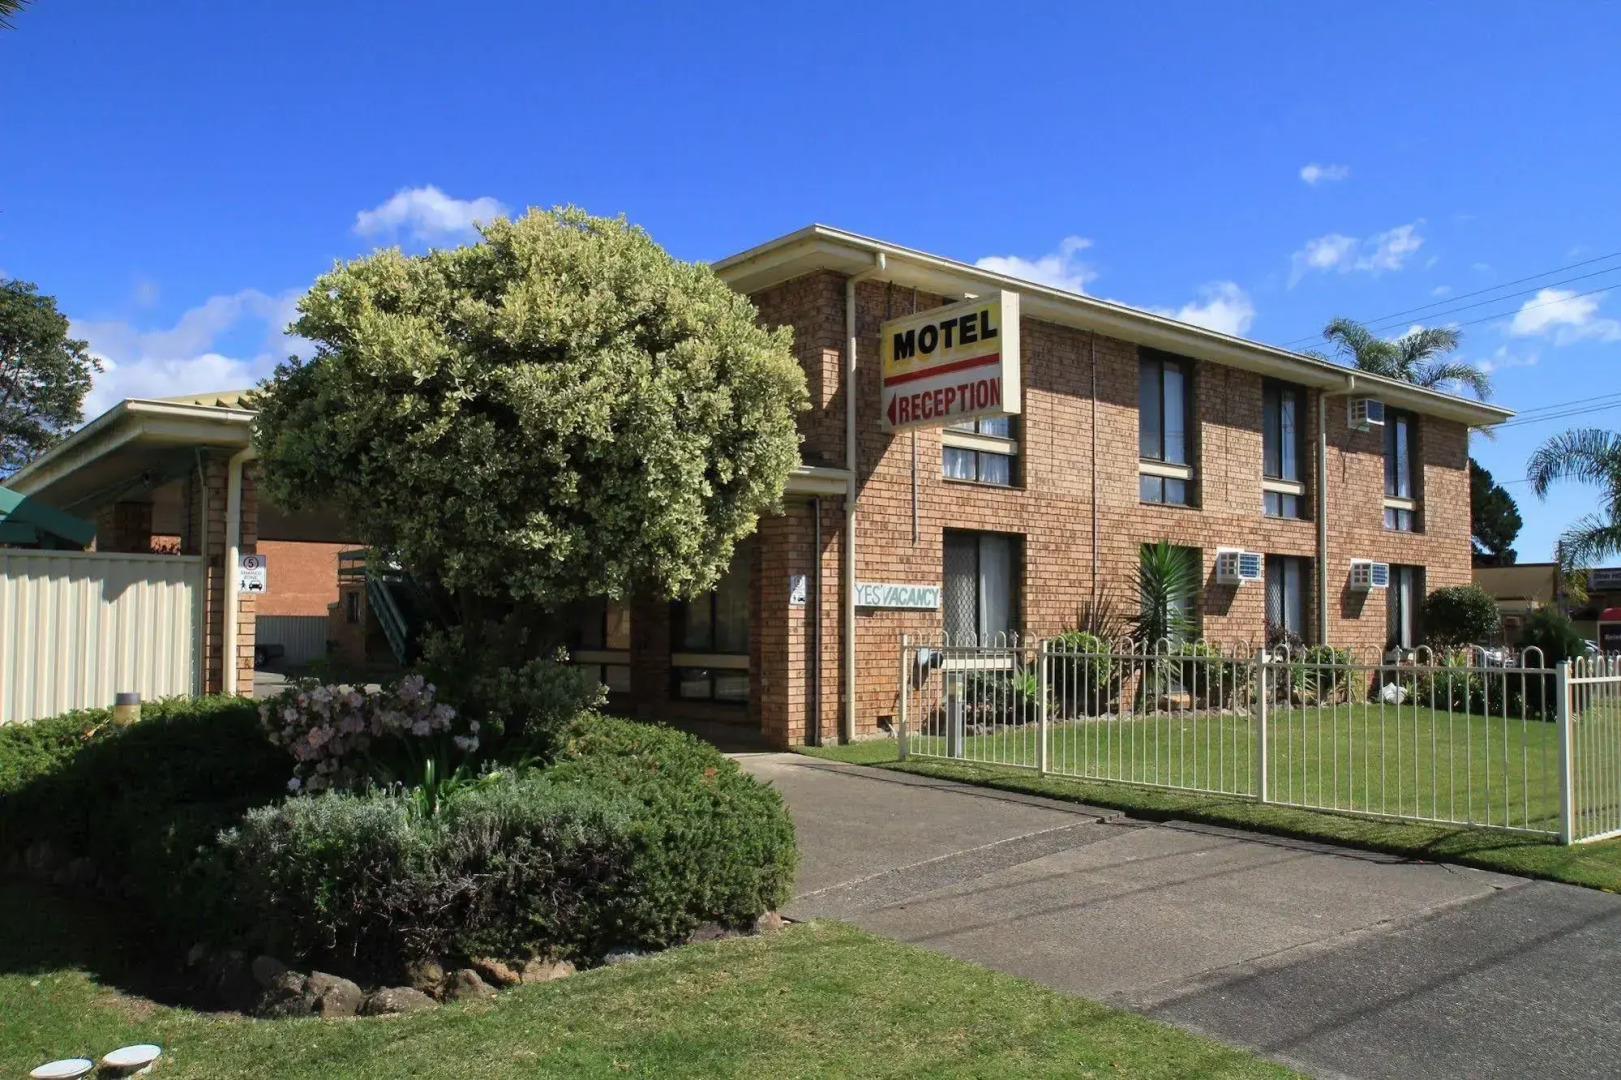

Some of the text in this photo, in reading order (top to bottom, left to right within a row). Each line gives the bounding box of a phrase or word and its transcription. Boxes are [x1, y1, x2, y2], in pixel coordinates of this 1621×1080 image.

[893, 309, 998, 361] MOTEL
[898, 376, 1001, 425] RECEPTION
[248, 558, 254, 568] 5
[883, 587, 939, 606] VACANCY
